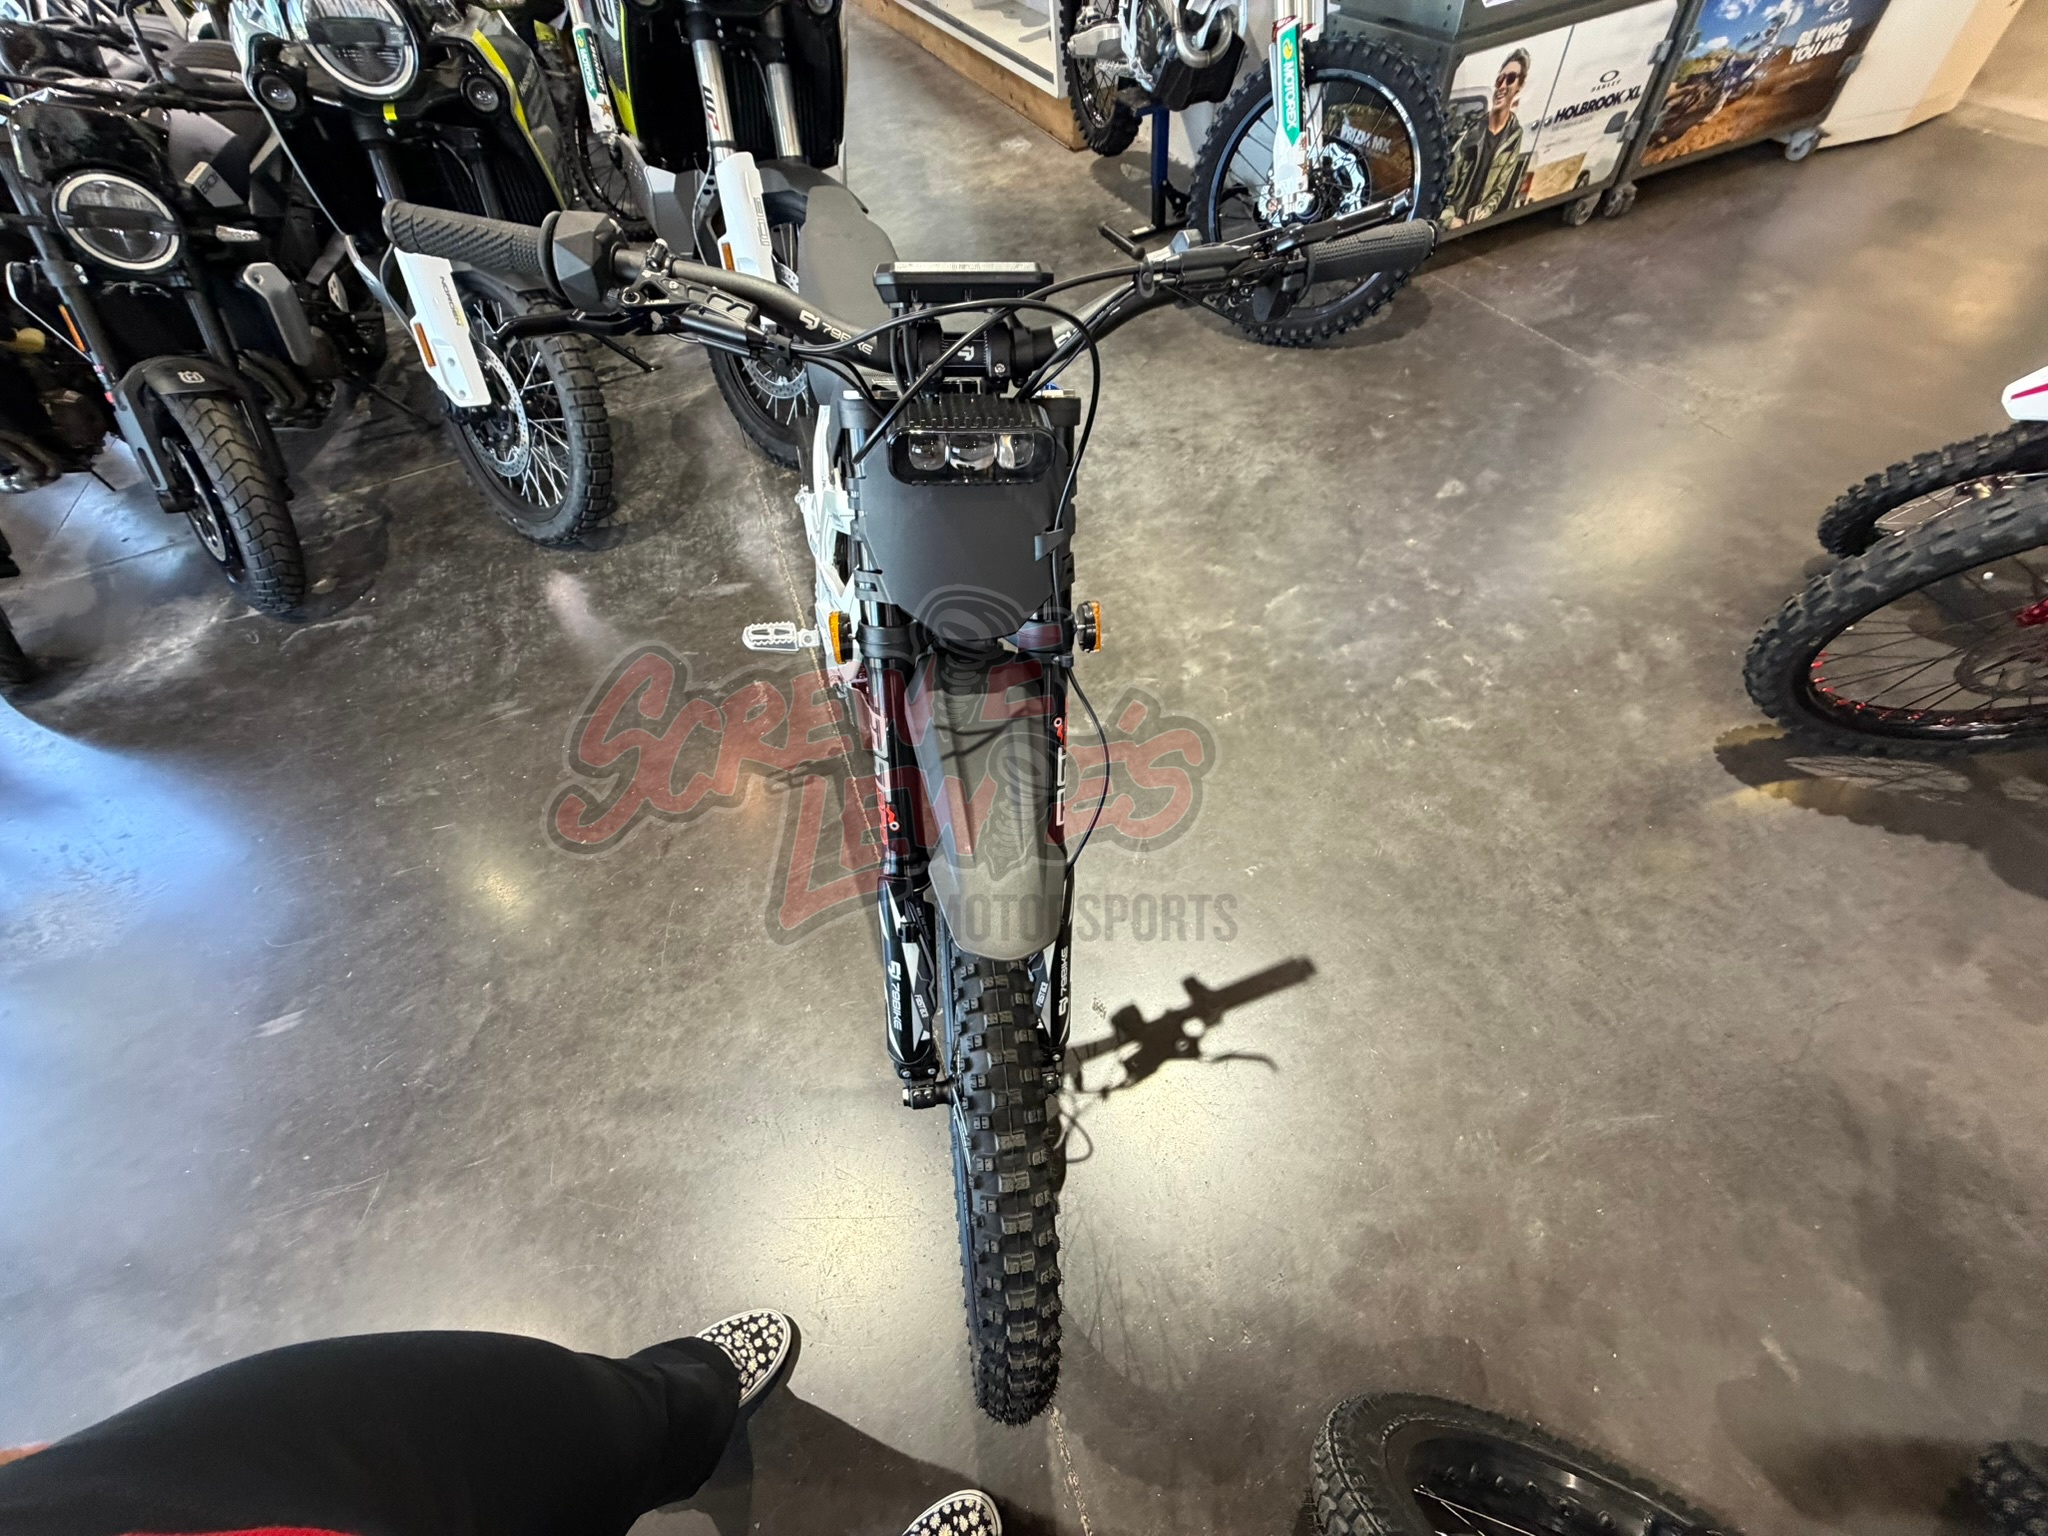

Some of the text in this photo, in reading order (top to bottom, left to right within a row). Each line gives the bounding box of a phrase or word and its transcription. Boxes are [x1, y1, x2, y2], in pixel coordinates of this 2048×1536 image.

[1788, 33, 1850, 65] YOU ARE
[1815, 17, 1853, 42] WHO
[580, 48, 597, 91] MOTOREX
[1283, 61, 1297, 131] MOTOREX
[1553, 89, 1626, 124] HOLBROOK
[1624, 84, 1642, 103] XL
[1371, 135, 1392, 154] MX
[439, 275, 462, 327] NORDEN
[821, 321, 875, 356] 79BKE
[1060, 945, 1069, 997] 79BIKE
[890, 981, 903, 1032] 79BIKE
